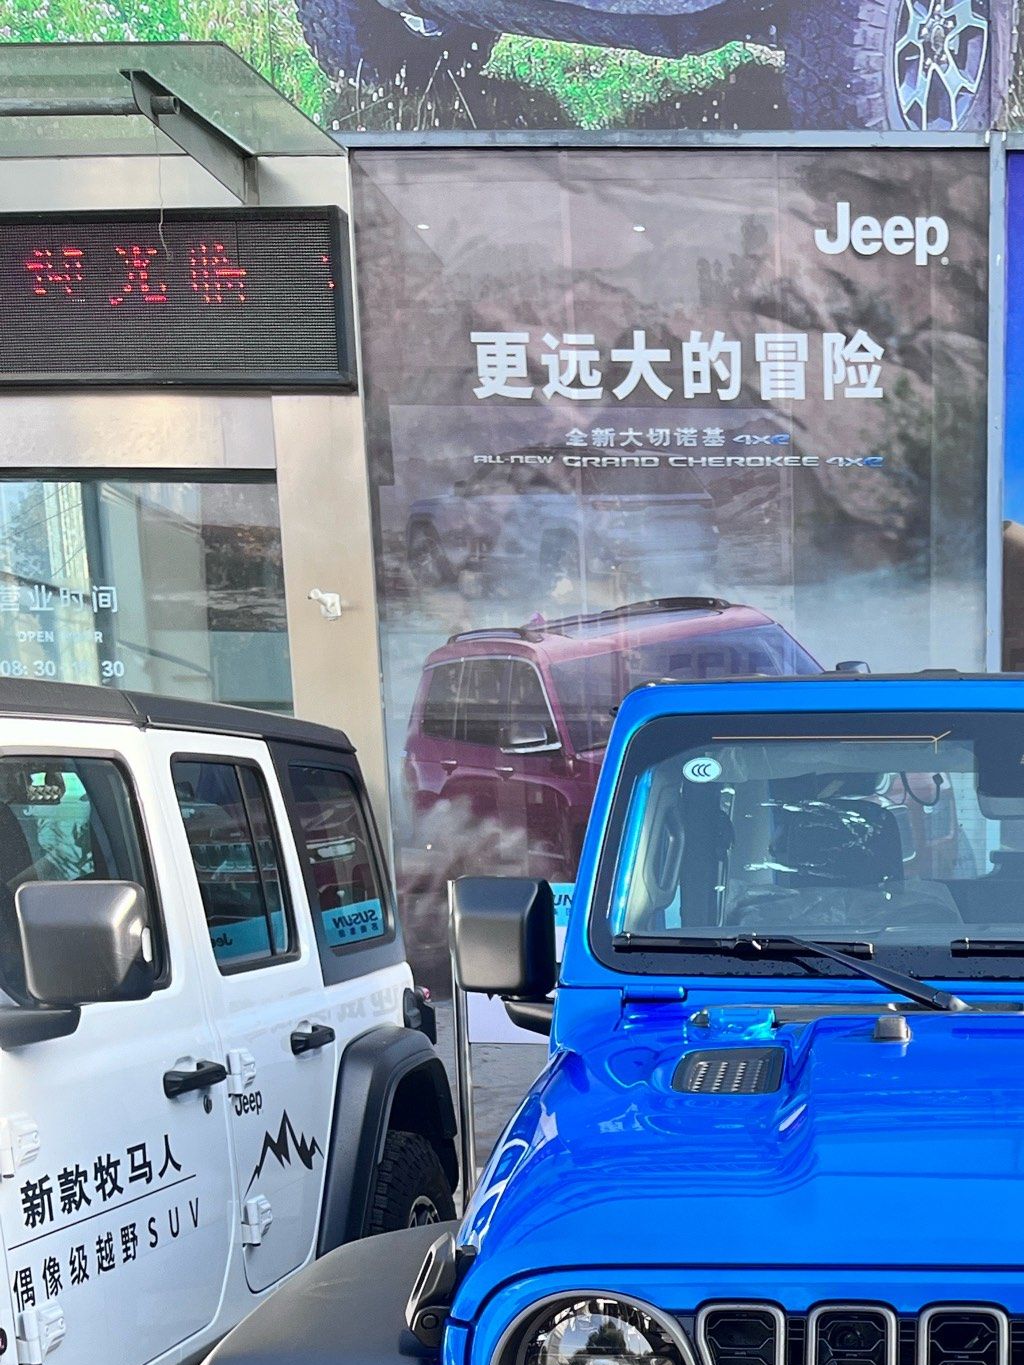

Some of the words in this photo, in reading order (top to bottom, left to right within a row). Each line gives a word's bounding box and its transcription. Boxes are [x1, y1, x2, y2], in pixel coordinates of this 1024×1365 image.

[814, 202, 949, 265] Jeep
[470, 329, 885, 401] 更远大的冒险
[565, 427, 726, 448] 全新大切诺基
[562, 456, 660, 468] GRAND
[668, 456, 819, 468] CHEROKEE
[18, 630, 54, 642] OPEN
[235, 1091, 262, 1117] Jeep
[20, 1133, 182, 1229] 新款牧马人
[13, 1197, 200, 1313] 偶像级越野SUV
